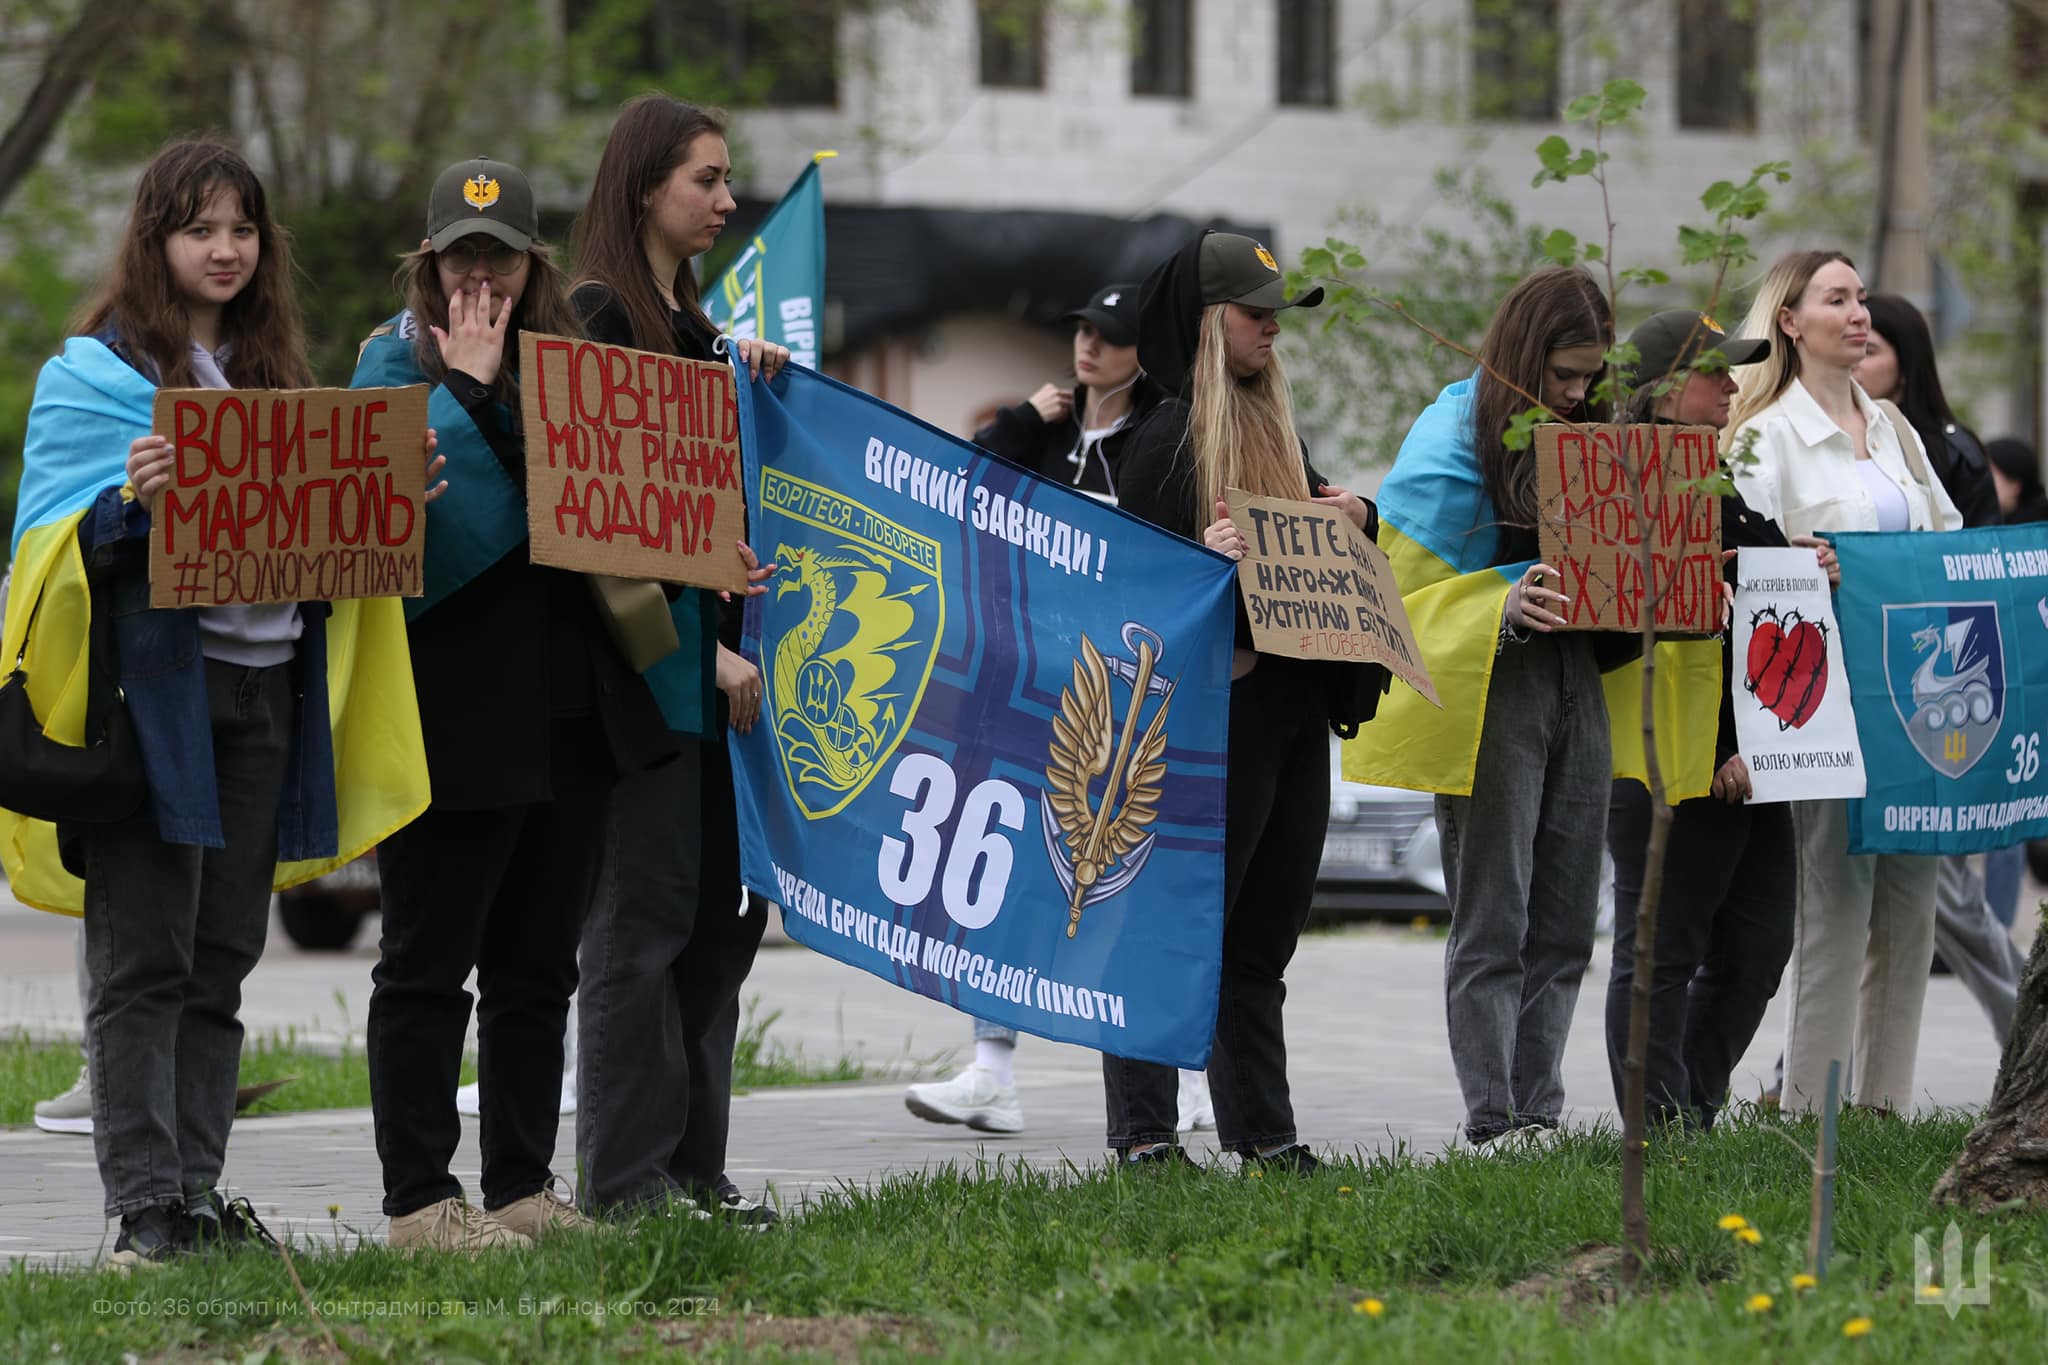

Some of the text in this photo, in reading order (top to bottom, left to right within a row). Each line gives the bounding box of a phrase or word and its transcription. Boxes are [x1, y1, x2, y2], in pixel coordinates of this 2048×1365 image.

[536, 340, 738, 444] ПОВЕРНІТЬ
[546, 421, 738, 491] МОЇХ РІДНИХ
[864, 436, 968, 522] ВІРНИЙ
[165, 472, 415, 555] МАРІУПОЛЬ
[554, 475, 716, 557] ДОДОМУ!
[766, 476, 934, 568] БОРІТЕСЯ ПОБОРЕТЕ
[1248, 507, 1348, 557] ТРЕТЄ
[172, 549, 420, 604] #ВОЛЮМОРПІХАМ
[1552, 553, 1599, 625] ЇХ
[1762, 577, 1785, 592] СЕРЦЕ
[1786, 577, 1792, 592] В
[1943, 547, 2006, 581] ВІРНИЙ
[1249, 593, 1350, 631] ЗУСТРІЧАЮ
[1752, 751, 1855, 771] ВОЛЮ МОРПІХАМ!
[2006, 732, 2040, 784] 36
[877, 753, 1026, 930] 36
[1884, 806, 1951, 832] ОКРЕМА
[771, 861, 1126, 1028] КРЕМА БРИГАДА МОРСЬКОЇ ПІХОТИ
